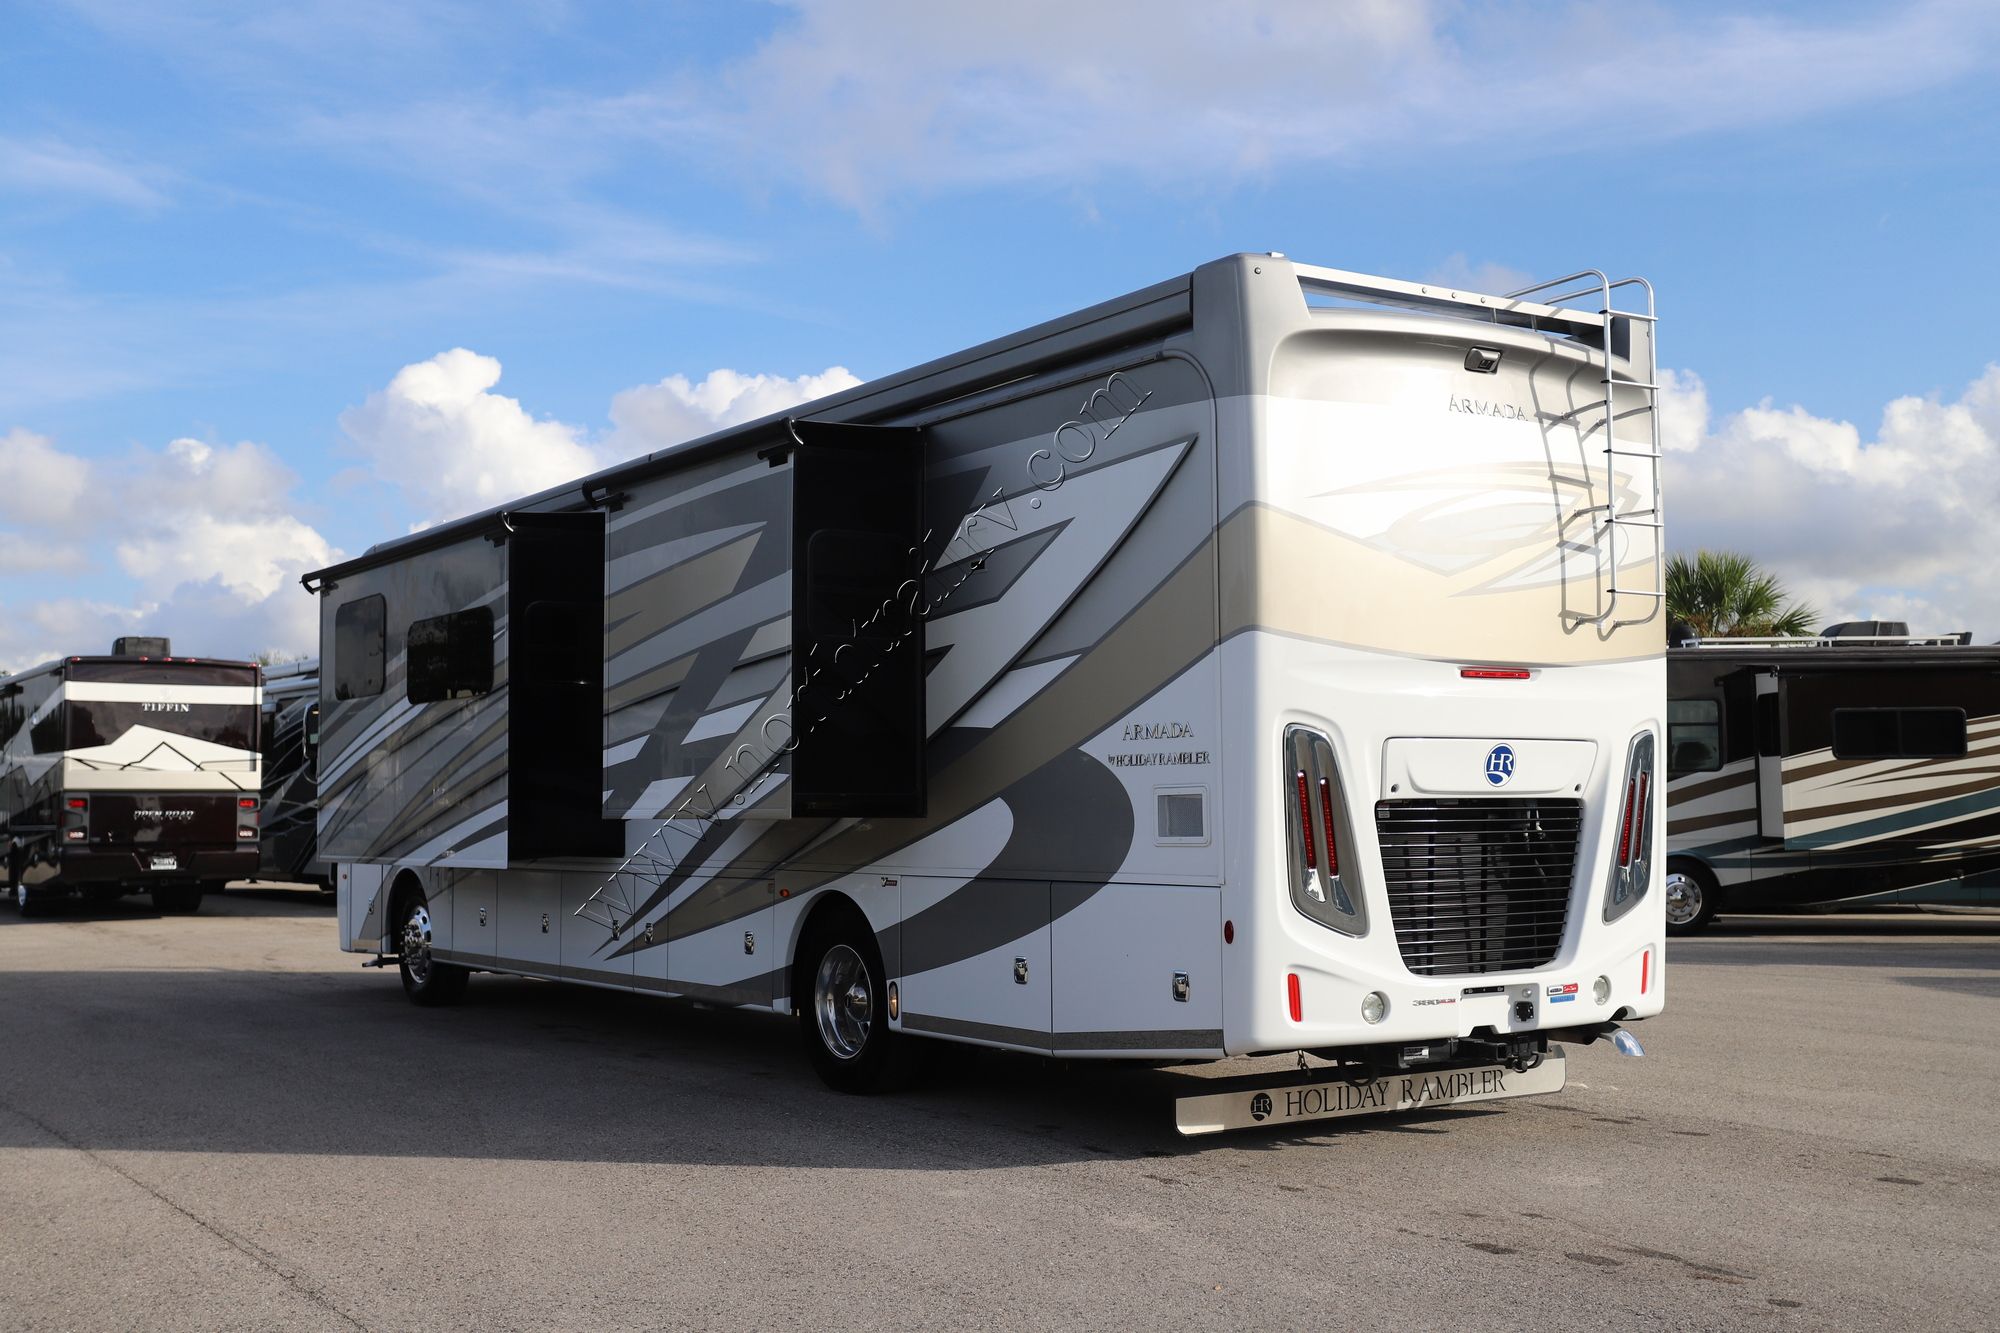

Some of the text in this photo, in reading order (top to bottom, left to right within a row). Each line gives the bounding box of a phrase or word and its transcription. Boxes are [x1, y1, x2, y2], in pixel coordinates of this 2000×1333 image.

[1449, 393, 1528, 421] ARMADA
[142, 702, 190, 712] TIFFIN
[1123, 722, 1195, 741] ARMADA
[1107, 751, 1211, 767] by HOLIDAY RAMBLER
[1285, 1081, 1389, 1118] HOLIDAY
[1402, 1069, 1507, 1104] RAMBLER
